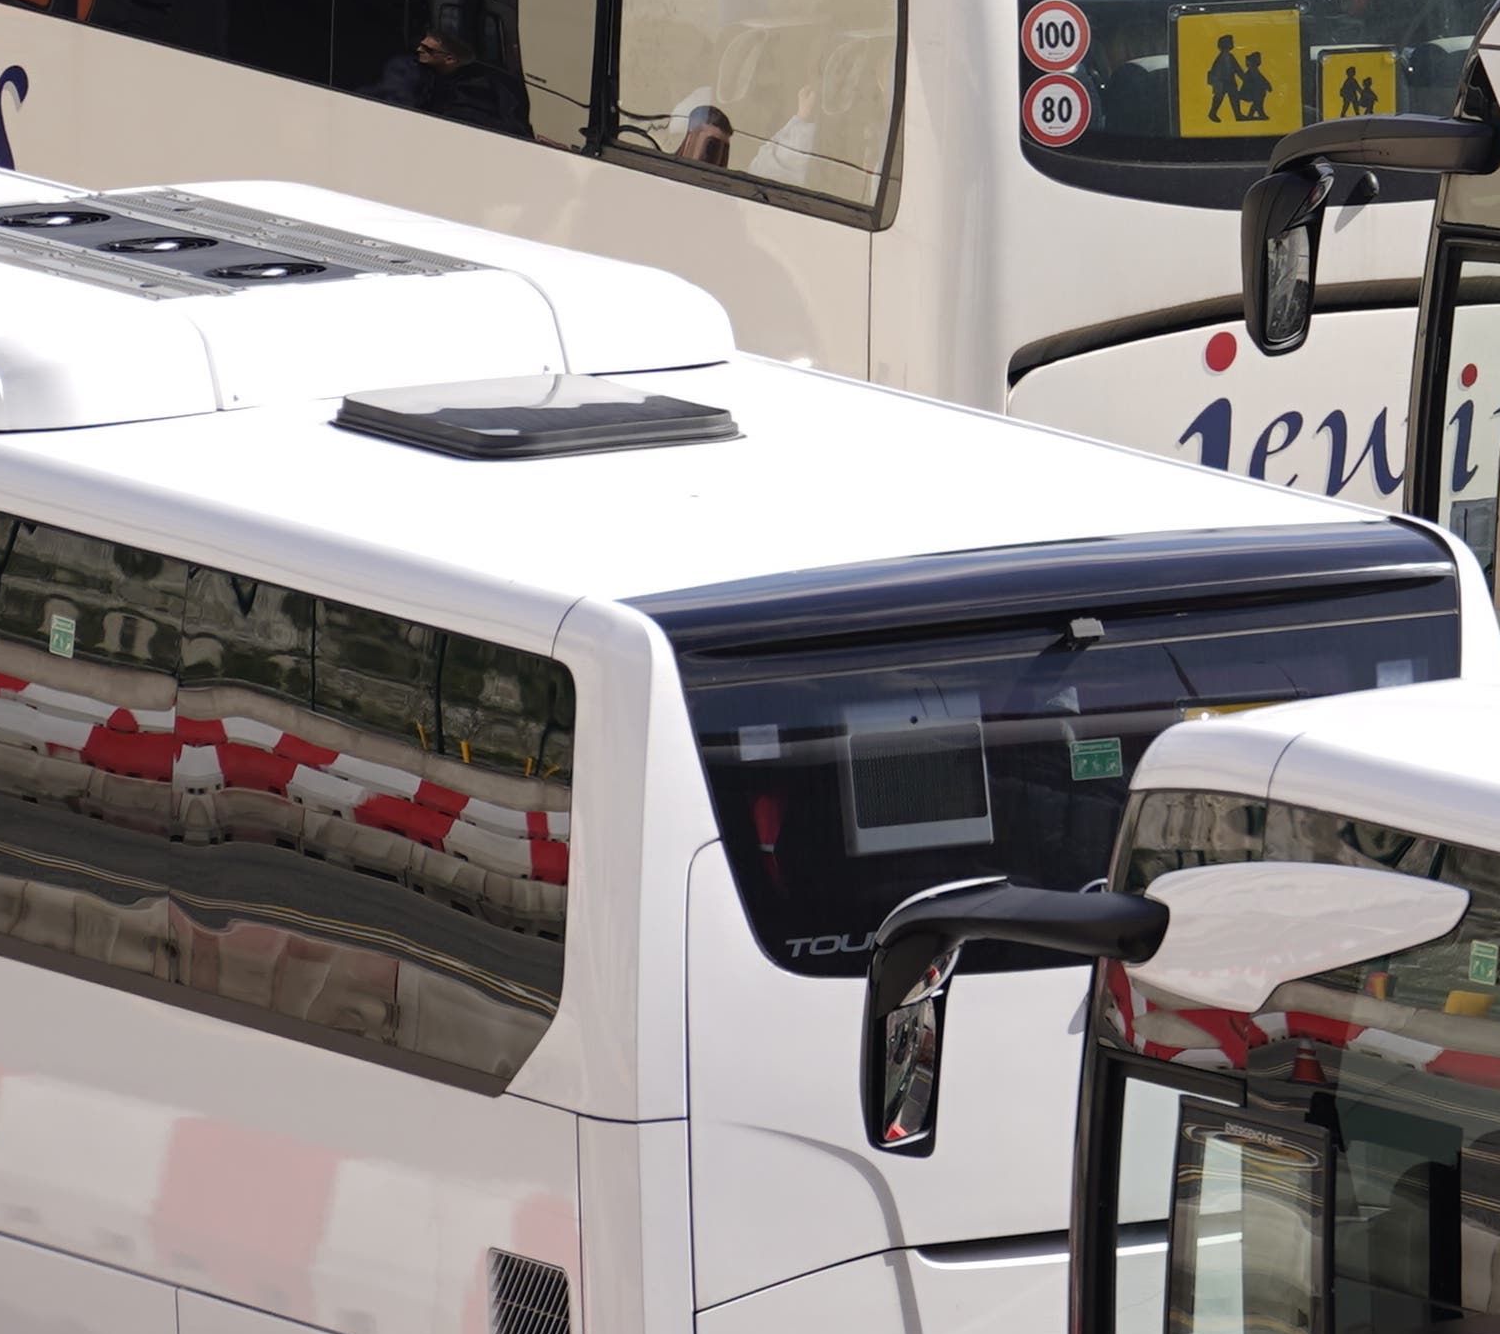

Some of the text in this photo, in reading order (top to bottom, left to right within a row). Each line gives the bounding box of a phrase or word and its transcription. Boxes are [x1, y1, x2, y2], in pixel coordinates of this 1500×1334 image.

[1035, 21, 1075, 49] 100
[1041, 97, 1073, 123] 80
[1224, 1122, 1263, 1142] EMERGENCY
